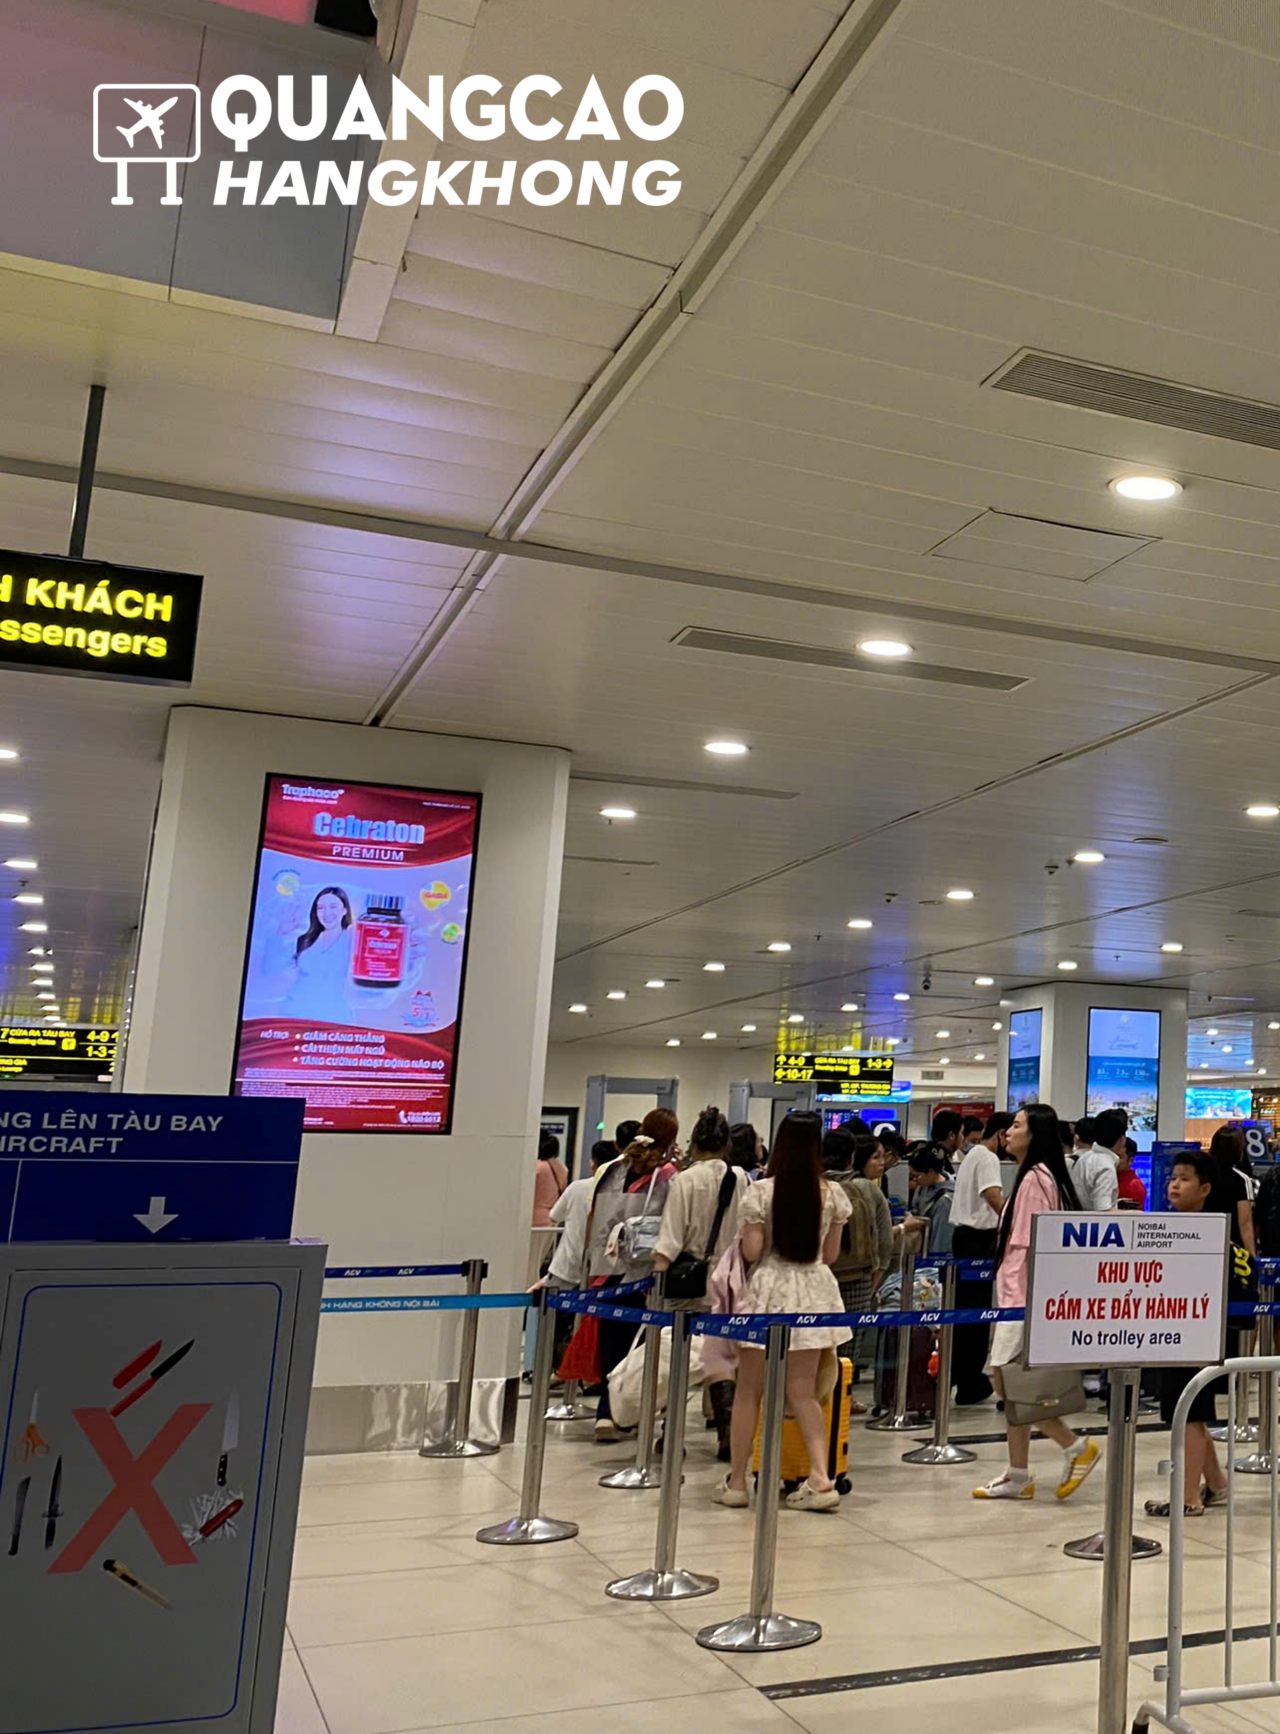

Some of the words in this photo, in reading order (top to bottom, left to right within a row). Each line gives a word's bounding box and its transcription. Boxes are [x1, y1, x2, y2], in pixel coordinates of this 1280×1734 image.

[26, 580, 172, 622] KHÁCH
[0, 619, 167, 657] ssengers
[282, 784, 338, 799] Traphaco
[314, 812, 425, 844] Cebraton
[333, 846, 404, 861] PREMIUM
[87, 1030, 110, 1042] 4-9
[86, 1046, 107, 1057] 1-3
[42, 1109, 97, 1130] LÊN
[107, 1111, 161, 1131] TÀU
[170, 1116, 223, 1132] BAY
[1246, 1129, 1265, 1157] 8
[1062, 1222, 1125, 1247] NIA
[1137, 1232, 1201, 1240] INTERNATIONAL
[1097, 1262, 1129, 1283] KHU
[1134, 1259, 1163, 1287] VỰC
[1045, 1290, 1082, 1320] CẤM
[1086, 1298, 1106, 1320] XE
[1111, 1289, 1141, 1319] ĐẨY
[1146, 1293, 1188, 1319] HÀNH
[1192, 1293, 1210, 1319] LÝ
[728, 1317, 749, 1325] ACV
[796, 1315, 817, 1324] ACV
[858, 1315, 879, 1323] ACV
[920, 1313, 940, 1321] ACV
[980, 1311, 1000, 1319] ACV
[1072, 1330, 1092, 1346] No
[1097, 1330, 1144, 1349] trolley
[1150, 1333, 1181, 1344] area
